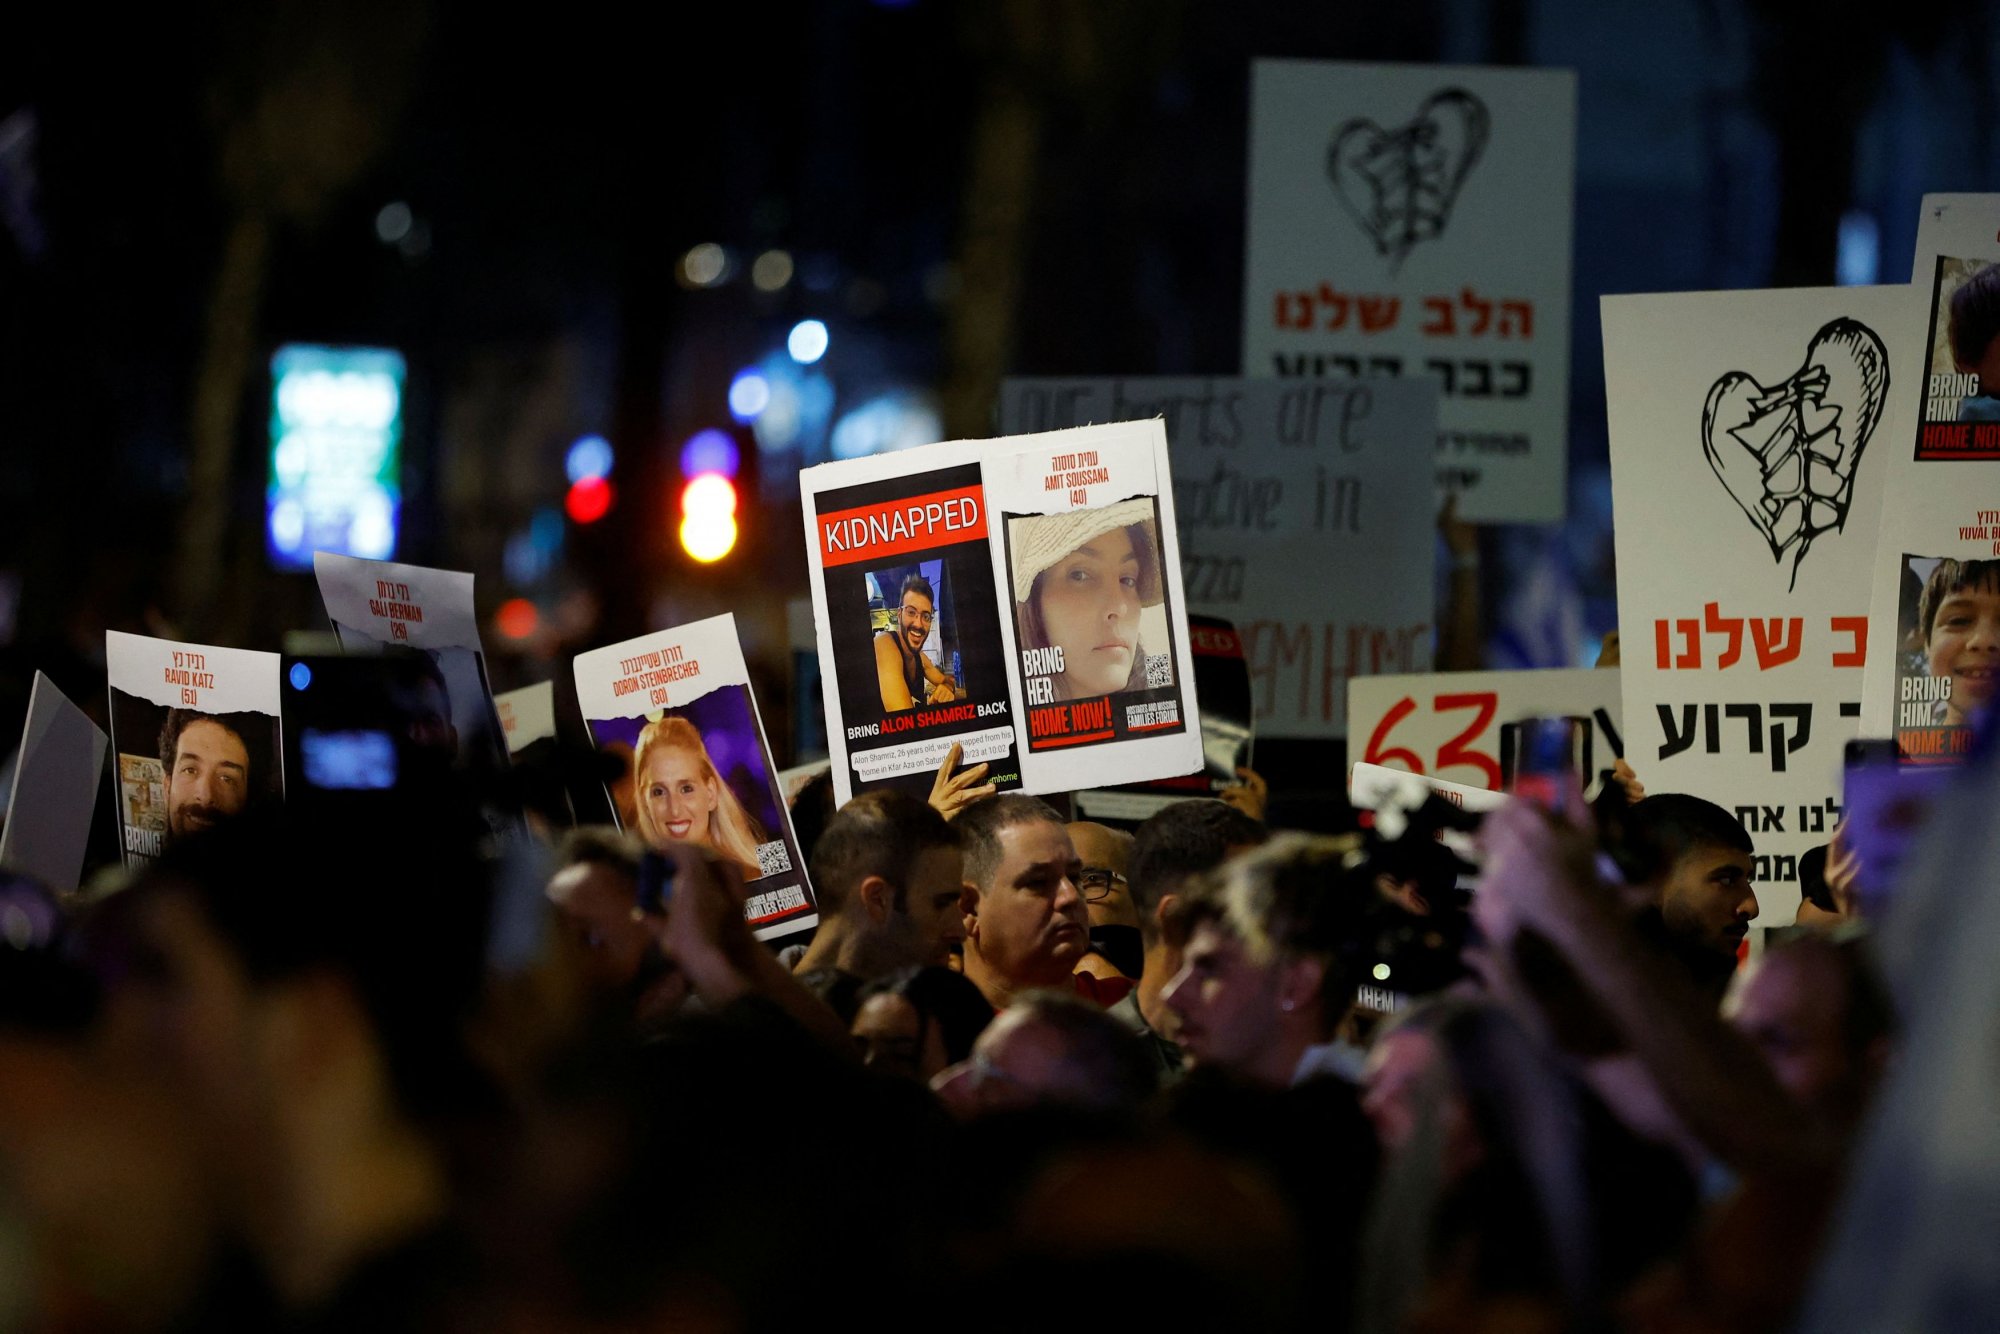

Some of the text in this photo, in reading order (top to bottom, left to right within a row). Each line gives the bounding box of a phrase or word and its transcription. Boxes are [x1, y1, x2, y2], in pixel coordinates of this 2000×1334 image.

[1274, 283, 1535, 338] הלב שלנו
[1424, 357, 1532, 398] כבר
[1928, 372, 1980, 398] BRING
[1277, 383, 1374, 453] are
[1925, 397, 1960, 422] HIM
[1921, 424, 2000, 449] HOME NO
[1077, 450, 1098, 468] עמית
[1045, 467, 1109, 491] AMIT SOUSSANA
[1069, 488, 1087, 507] (40)
[1313, 466, 1361, 534] in
[824, 496, 978, 553] KIDNAPPED
[1959, 526, 1989, 540] YUVAL
[369, 599, 423, 623] GALI BERMAN
[390, 620, 409, 642] (26)
[1655, 601, 1804, 671] שלנו
[1022, 645, 1065, 677] BRING
[165, 667, 214, 689] RAVID KATZ
[613, 660, 700, 697] DORON STEINBRECHER
[1026, 676, 1055, 706] HER
[1901, 675, 1952, 701] BRING
[181, 687, 197, 707] (51)
[650, 686, 668, 707] (30)
[847, 700, 1007, 740] BRING ALON SHAMRIZ BACK
[1030, 695, 1113, 737] HOME NOW!
[1127, 709, 1179, 728] FAMILIES FORUM
[854, 756, 869, 766] Alon
[897, 750, 906, 758] 26
[906, 748, 924, 758] years
[937, 742, 950, 751] was
[985, 733, 1001, 742] from
[1001, 731, 1012, 740] his
[1363, 691, 1502, 792] 63
[1656, 702, 1812, 772] קרוע
[1898, 729, 1973, 754] HOME NO
[862, 766, 880, 777] home
[888, 763, 902, 772] Kfar
[903, 761, 915, 769] Aza
[980, 747, 987, 756] at
[1735, 806, 1786, 833] את
[124, 825, 162, 858] BRING
[743, 901, 778, 921] AMILIES
